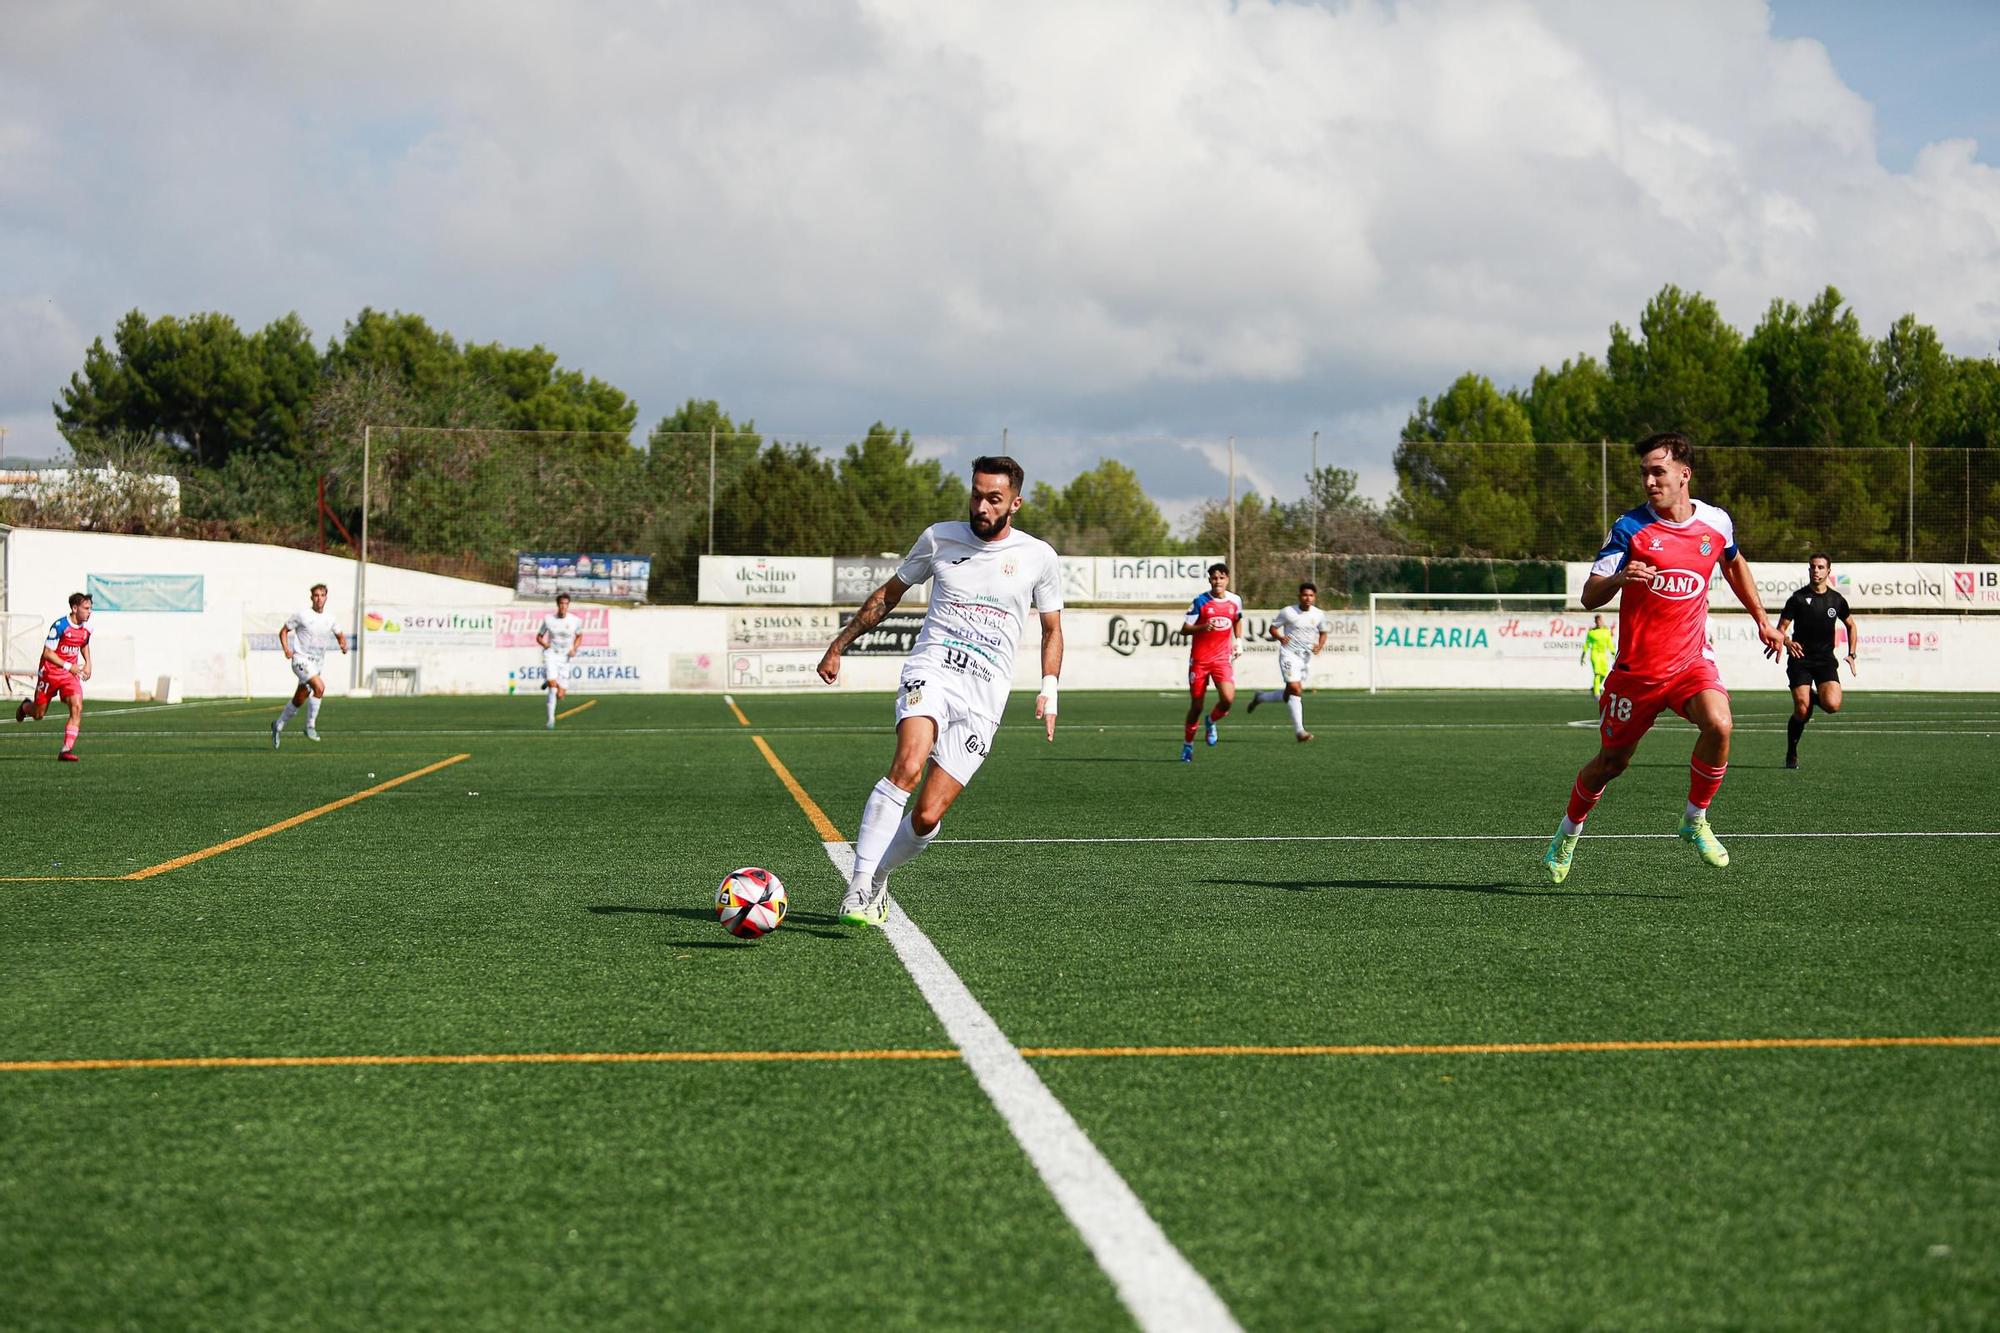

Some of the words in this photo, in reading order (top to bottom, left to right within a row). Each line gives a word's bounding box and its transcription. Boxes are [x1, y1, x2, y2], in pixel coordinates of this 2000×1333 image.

[736, 567, 796, 581] destino
[1112, 560, 1206, 579] infinitel
[1651, 576, 1696, 593] DANI
[1858, 579, 1943, 597] vestalia
[1978, 571, 1998, 588] IB
[404, 614, 493, 629] servifruit
[853, 630, 897, 651] epita
[1103, 615, 1141, 656] Las
[588, 665, 641, 680] RAFAEL
[1608, 692, 1633, 722] 18
